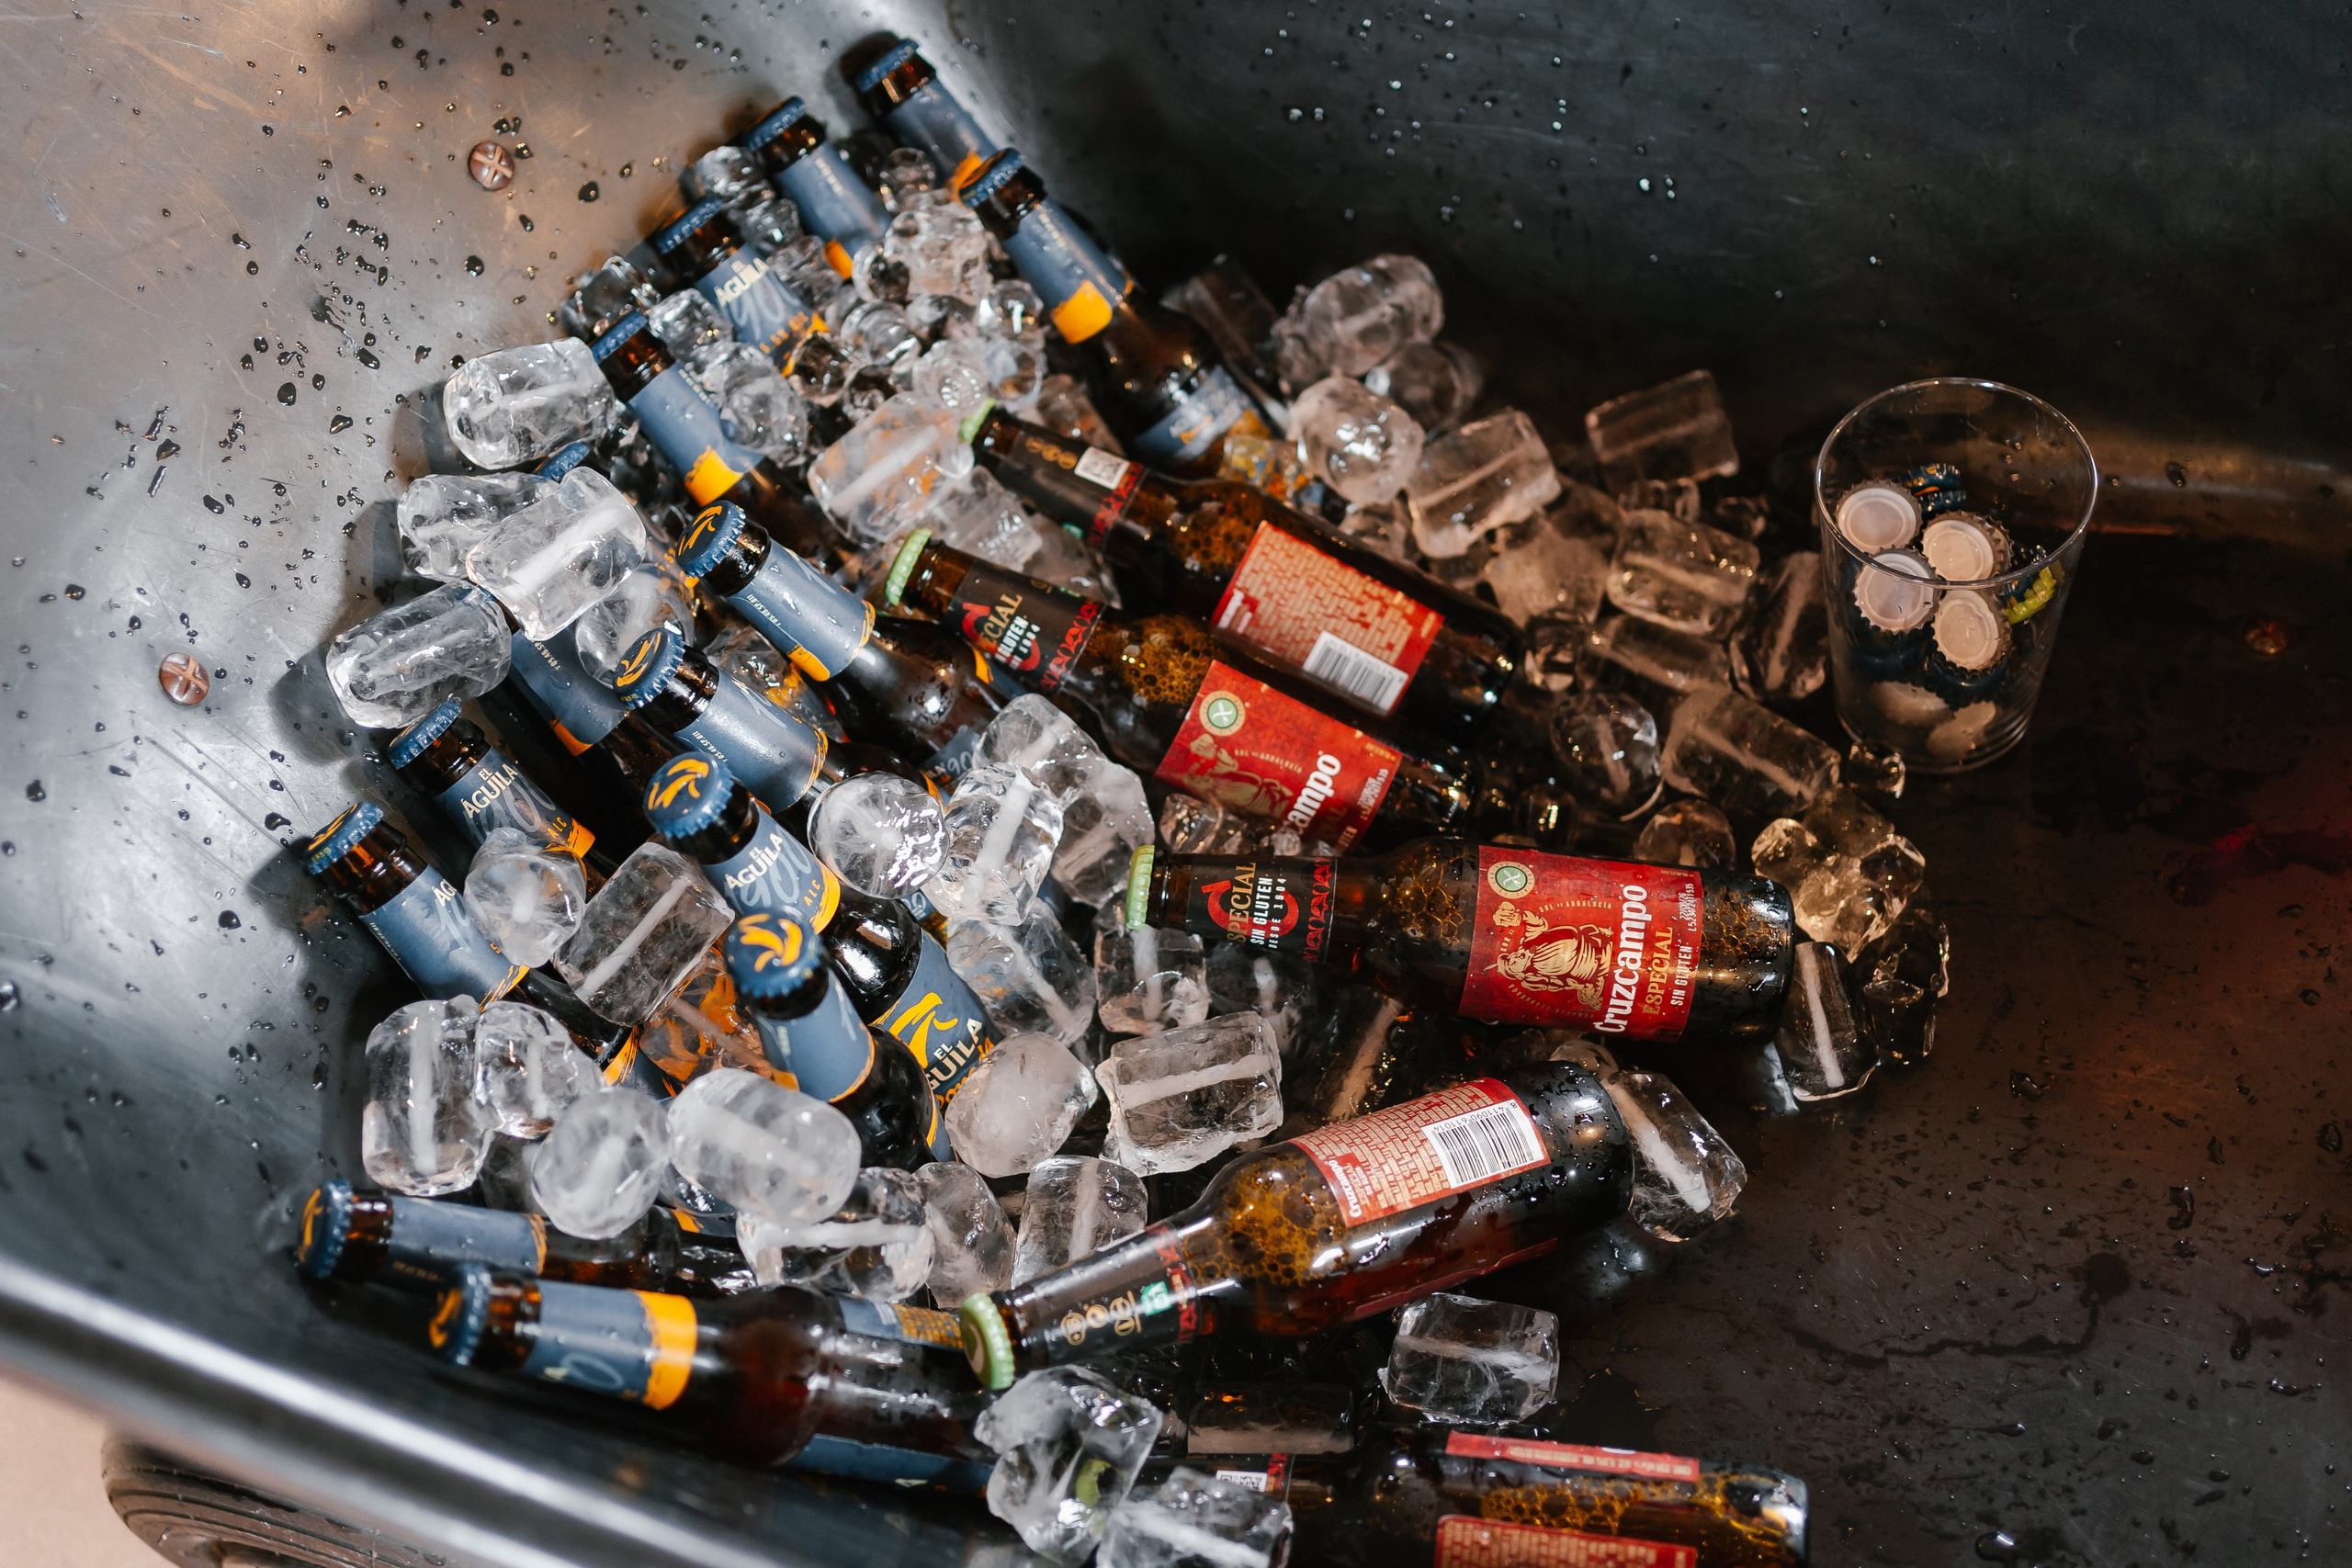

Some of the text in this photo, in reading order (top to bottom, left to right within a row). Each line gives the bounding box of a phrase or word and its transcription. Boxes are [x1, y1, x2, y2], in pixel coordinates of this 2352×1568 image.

[478, 768, 492, 780] EL
[460, 763, 518, 818] ÁGUILA
[547, 817, 567, 838] ALC
[749, 847, 763, 860] EL
[804, 879, 821, 906] ALC
[1227, 863, 1256, 942] SPECIAL
[1273, 878, 1286, 909] 1904
[1250, 877, 1272, 945] SIN GLUTEN
[1593, 885, 1652, 1032] Cruzcampo
[1643, 927, 1673, 1015] ESPECIAL
[1670, 945, 1692, 1006] SIN GLUTEN
[933, 1043, 953, 1058] EL
[1434, 1118, 1467, 1132] 611014
[1470, 1107, 1504, 1122] 411090
